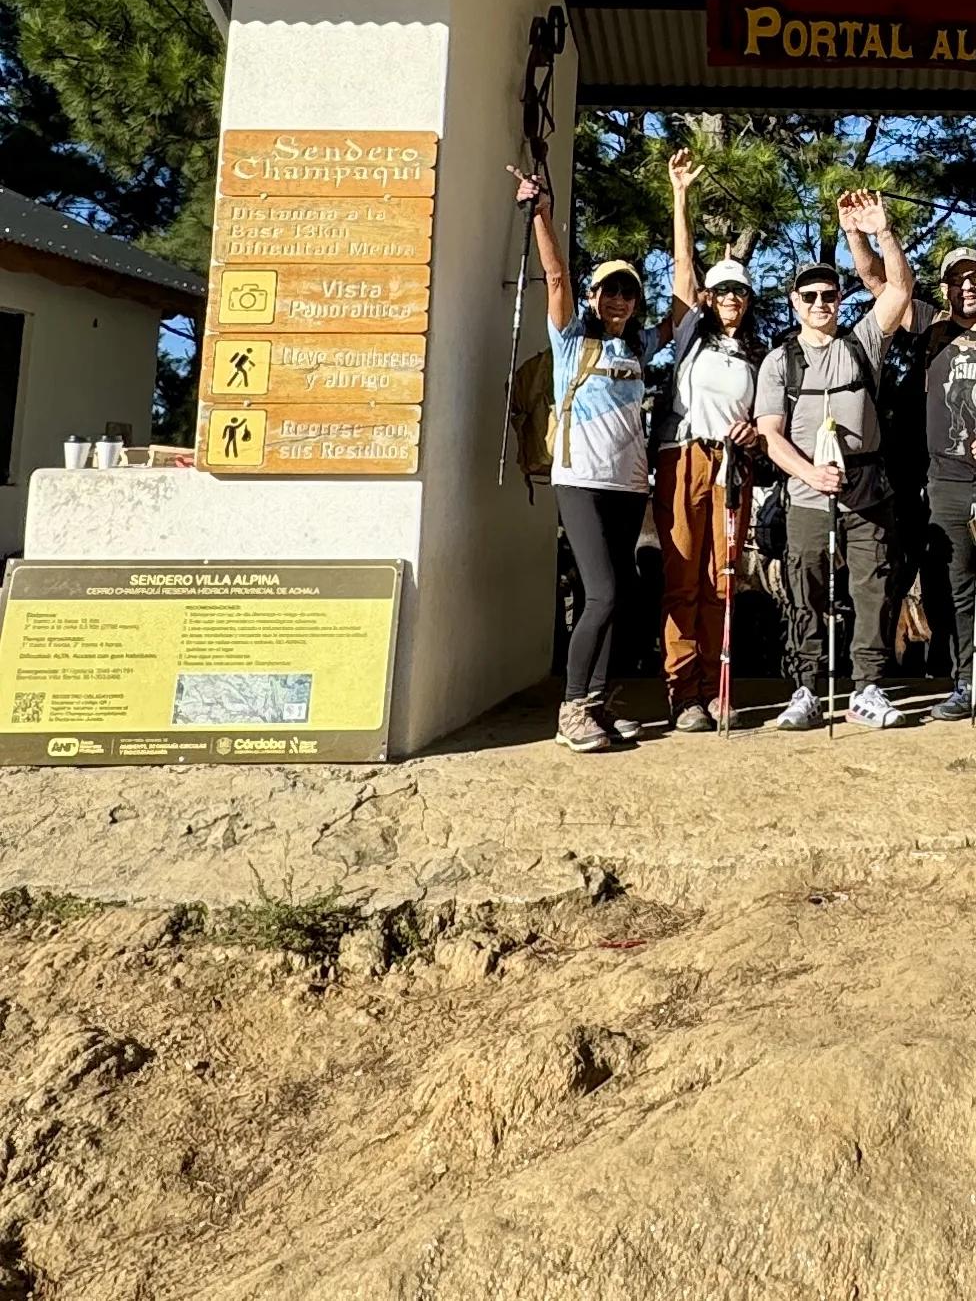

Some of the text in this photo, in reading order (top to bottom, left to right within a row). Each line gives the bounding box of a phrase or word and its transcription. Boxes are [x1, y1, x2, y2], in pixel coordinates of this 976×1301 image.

[744, 6, 914, 60] PORTAL
[272, 135, 419, 162] Sendero
[230, 224, 285, 239] Base
[228, 241, 340, 256] Dificultad
[322, 280, 382, 299] Vista
[305, 372, 317, 391] y
[321, 442, 409, 460] Residuos
[129, 574, 280, 587] SENDERO VILLA ALPINA
[86, 587, 114, 596] CERRO
[161, 587, 196, 596] RESERVA
[276, 587, 288, 596] DE
[288, 587, 320, 596] ACHALA
[234, 737, 286, 750] Córdoba
